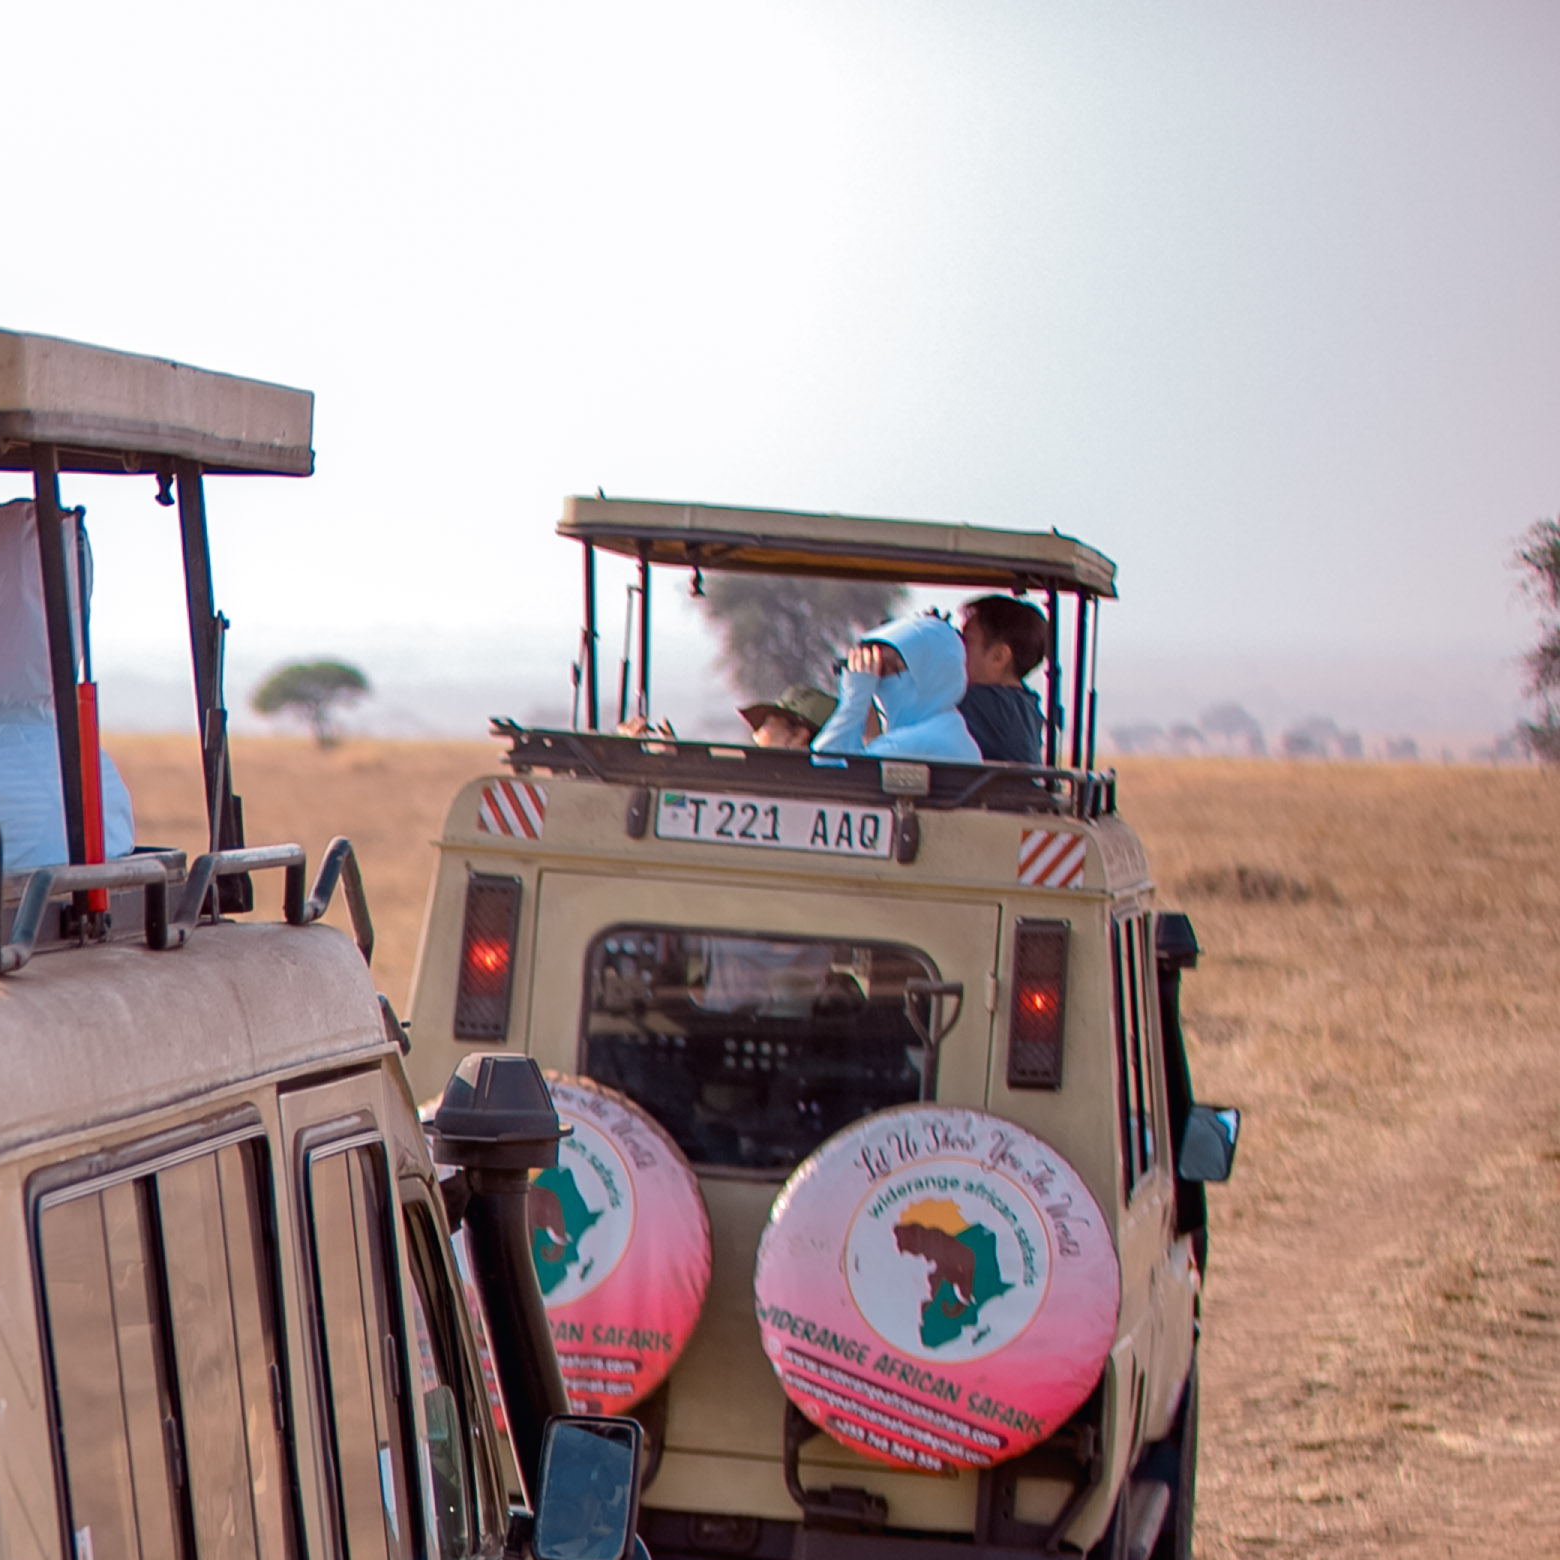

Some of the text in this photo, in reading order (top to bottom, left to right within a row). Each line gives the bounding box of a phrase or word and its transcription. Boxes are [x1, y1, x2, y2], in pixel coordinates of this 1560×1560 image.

[688, 799, 880, 850] T221 AAQ
[867, 1173, 961, 1221] widerange
[963, 1177, 1019, 1227] african
[592, 1323, 673, 1353] SAFARIS
[758, 1302, 872, 1367] WIDERANGE
[873, 1354, 962, 1405] AFRICAN
[966, 1390, 1047, 1437] SAFARIS
